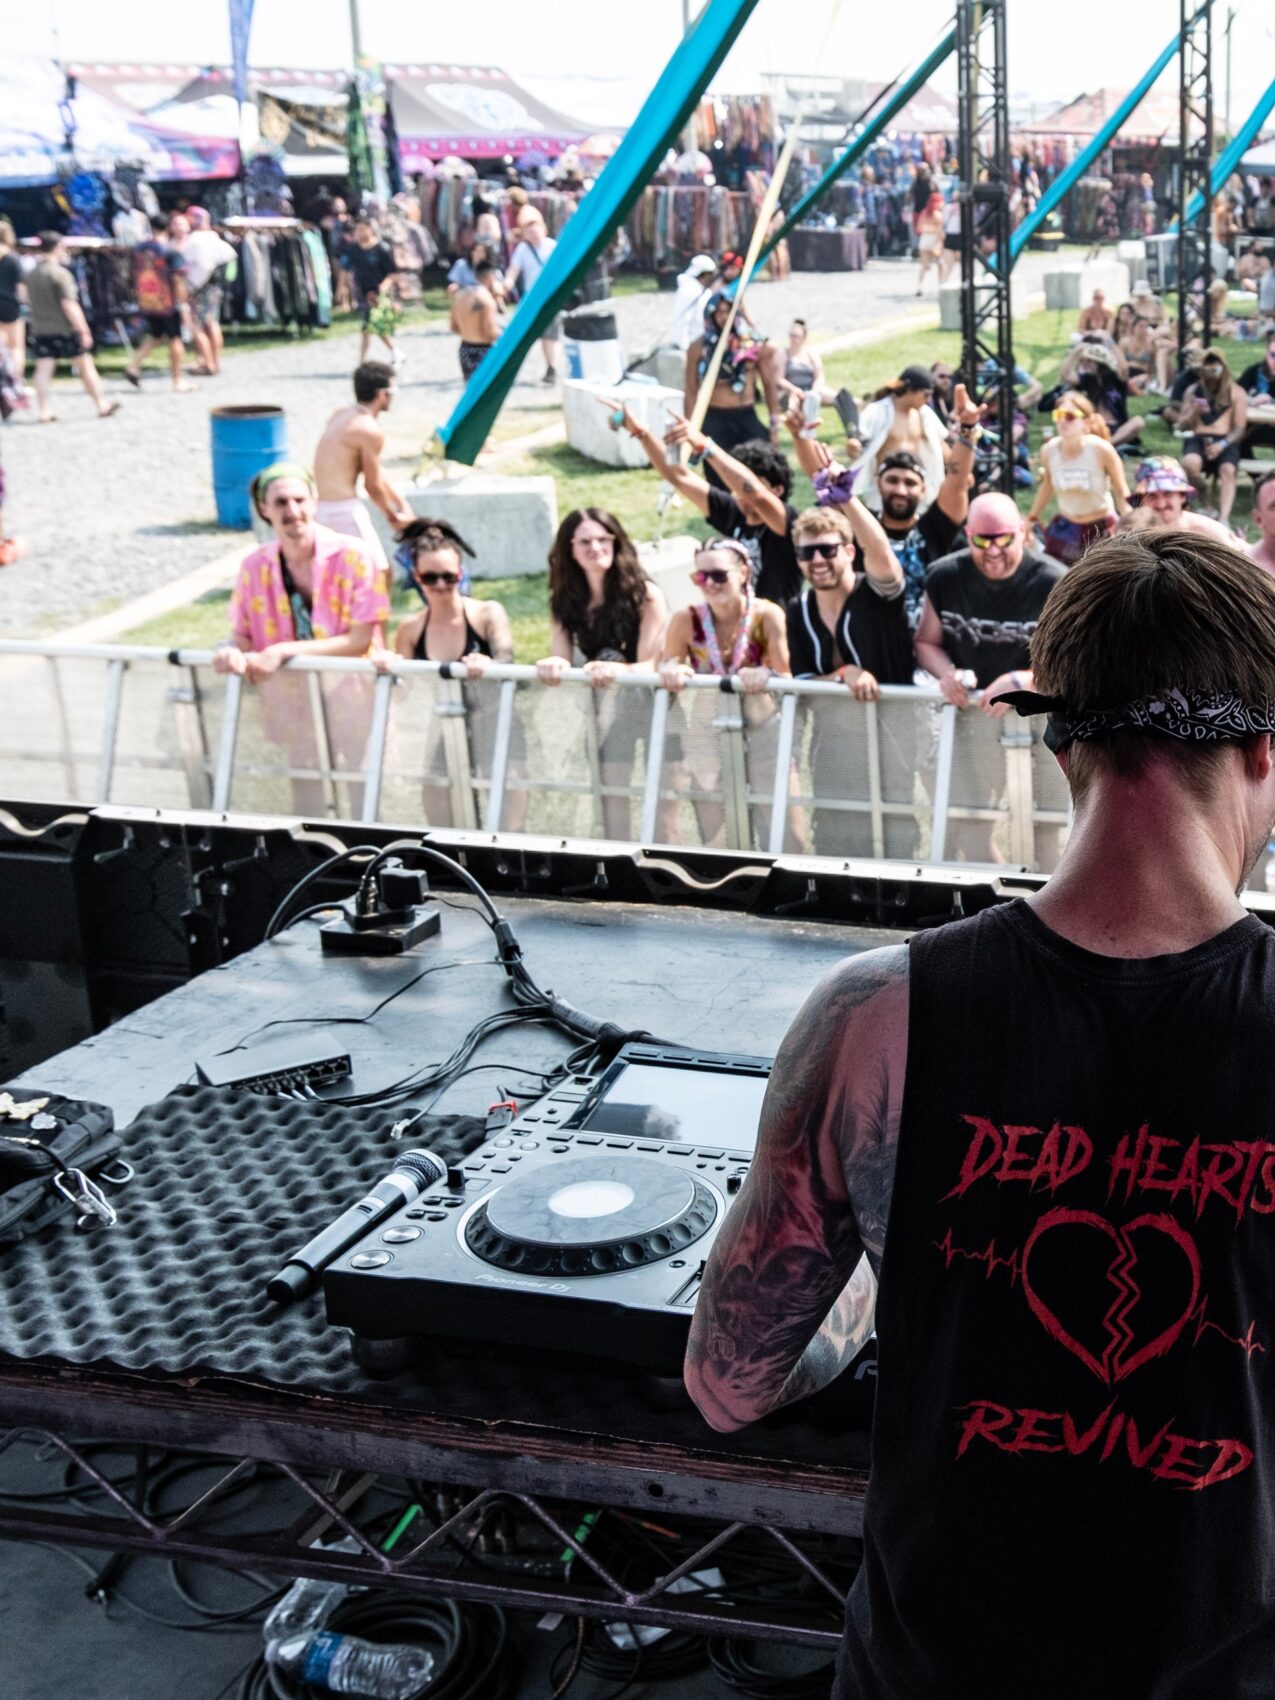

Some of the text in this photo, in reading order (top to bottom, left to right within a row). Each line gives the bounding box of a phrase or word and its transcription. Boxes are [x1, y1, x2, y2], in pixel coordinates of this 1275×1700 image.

[936, 1112, 1095, 1203] DEAD
[474, 1273, 573, 1293] Pioneer DJ
[951, 1397, 1255, 1492] REVIVED
